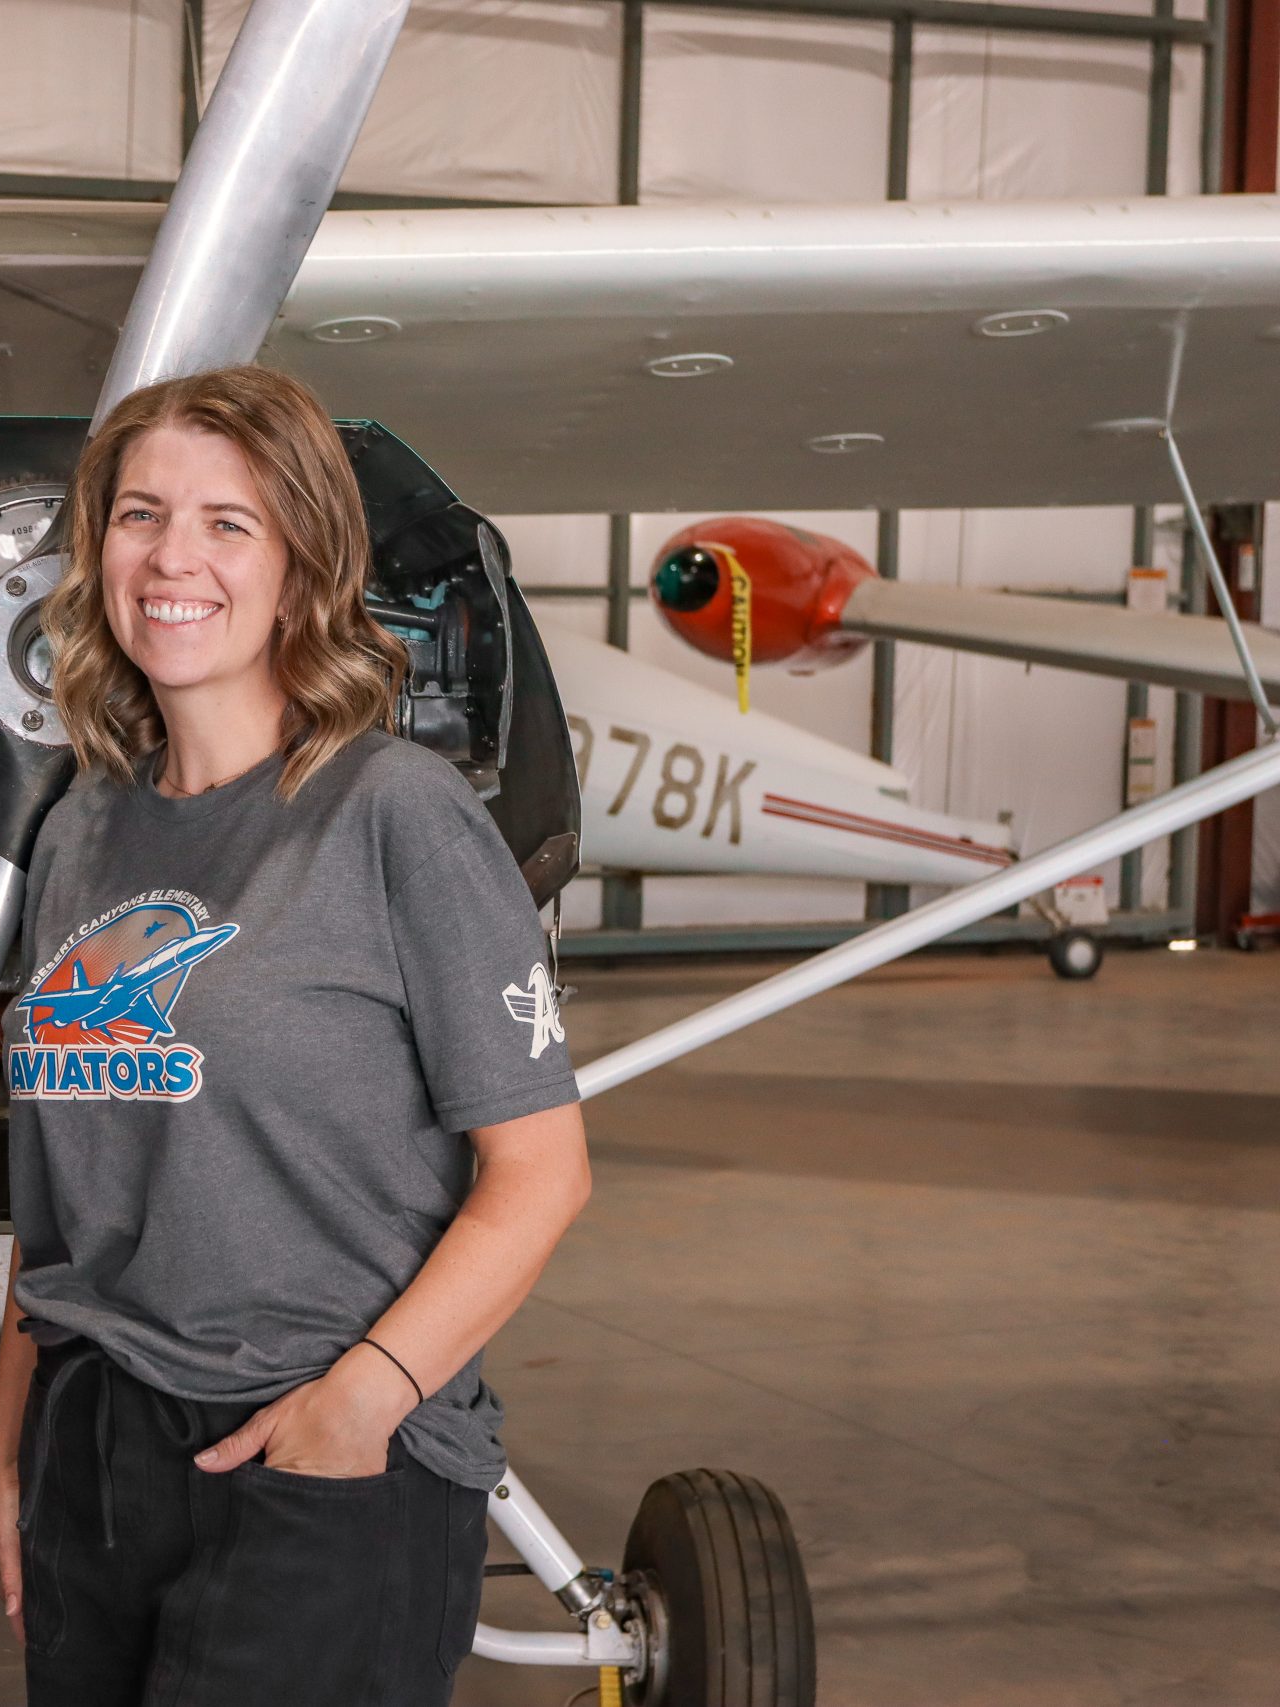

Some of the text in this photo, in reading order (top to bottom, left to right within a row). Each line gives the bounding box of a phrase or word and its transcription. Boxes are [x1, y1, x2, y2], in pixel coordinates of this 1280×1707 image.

[30, 889, 211, 986] DESERT CANYONS ELEMENTARY
[10, 1046, 199, 1098] AVIATORS
